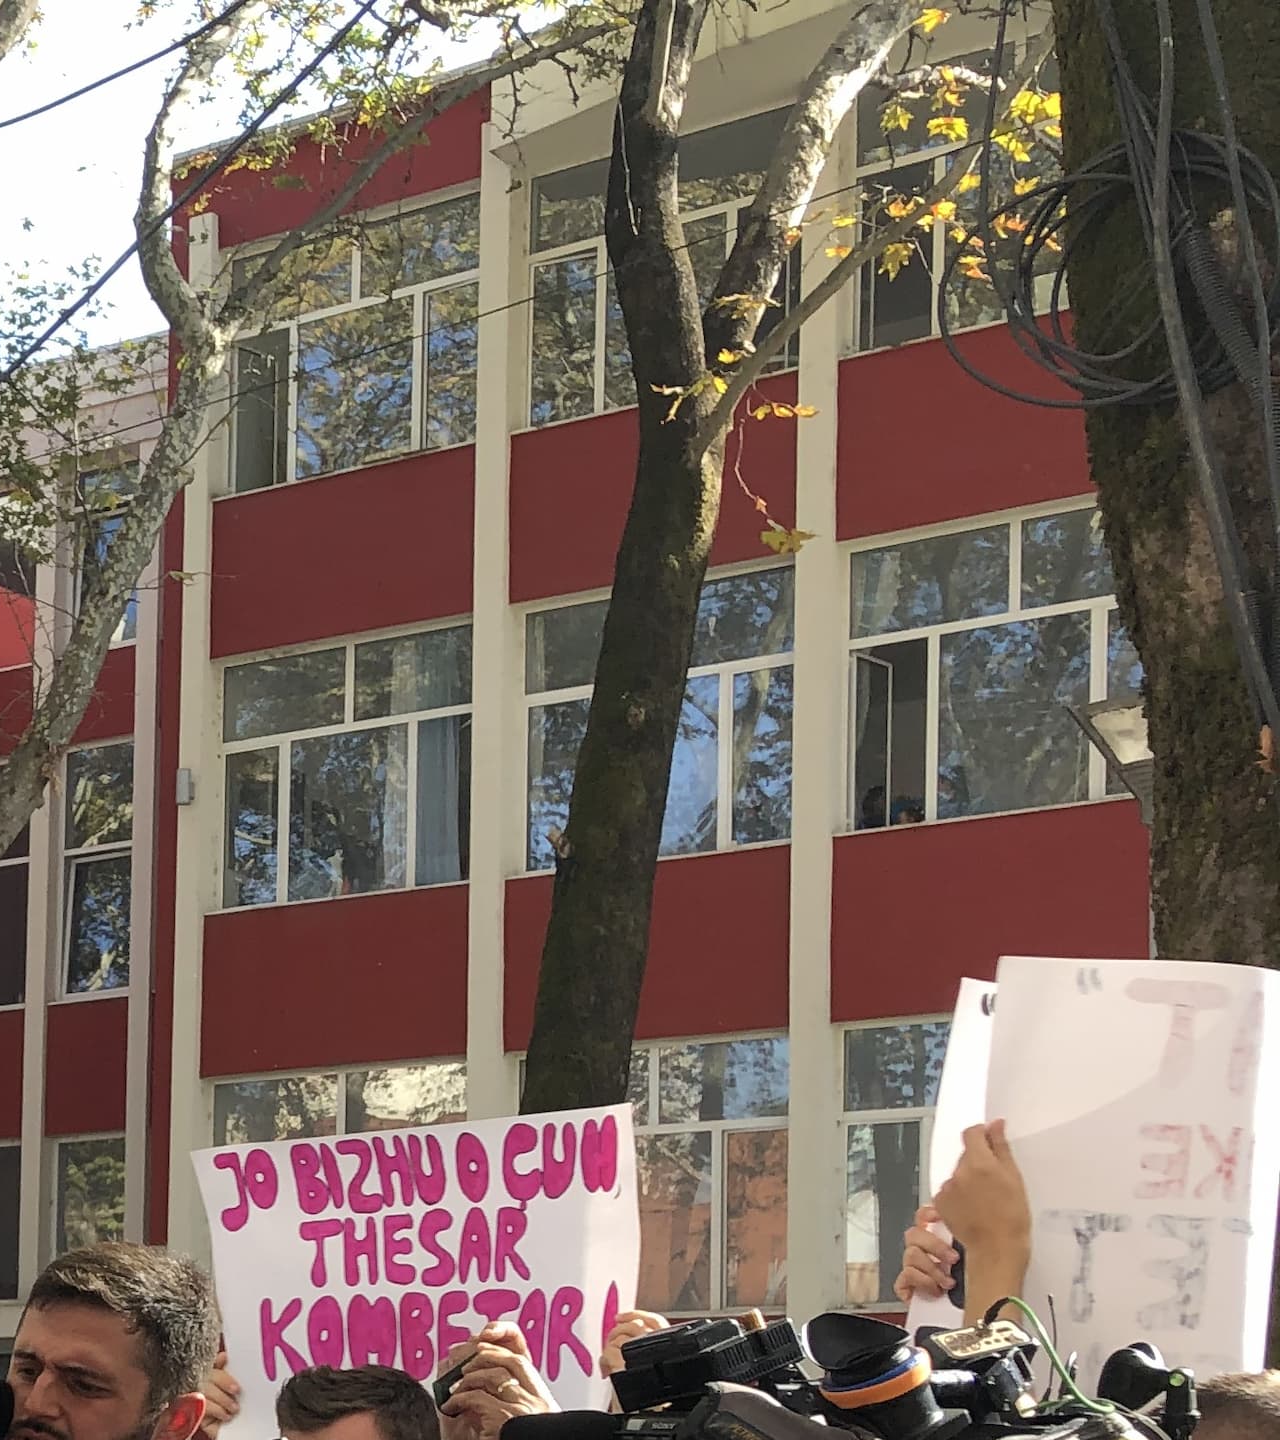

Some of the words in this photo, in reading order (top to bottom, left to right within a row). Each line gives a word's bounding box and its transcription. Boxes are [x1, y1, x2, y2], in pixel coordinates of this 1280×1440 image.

[213, 1148, 279, 1232] JO
[290, 1133, 446, 1215] BIZHU
[455, 1131, 489, 1203] O
[299, 1206, 531, 1288] THESAR
